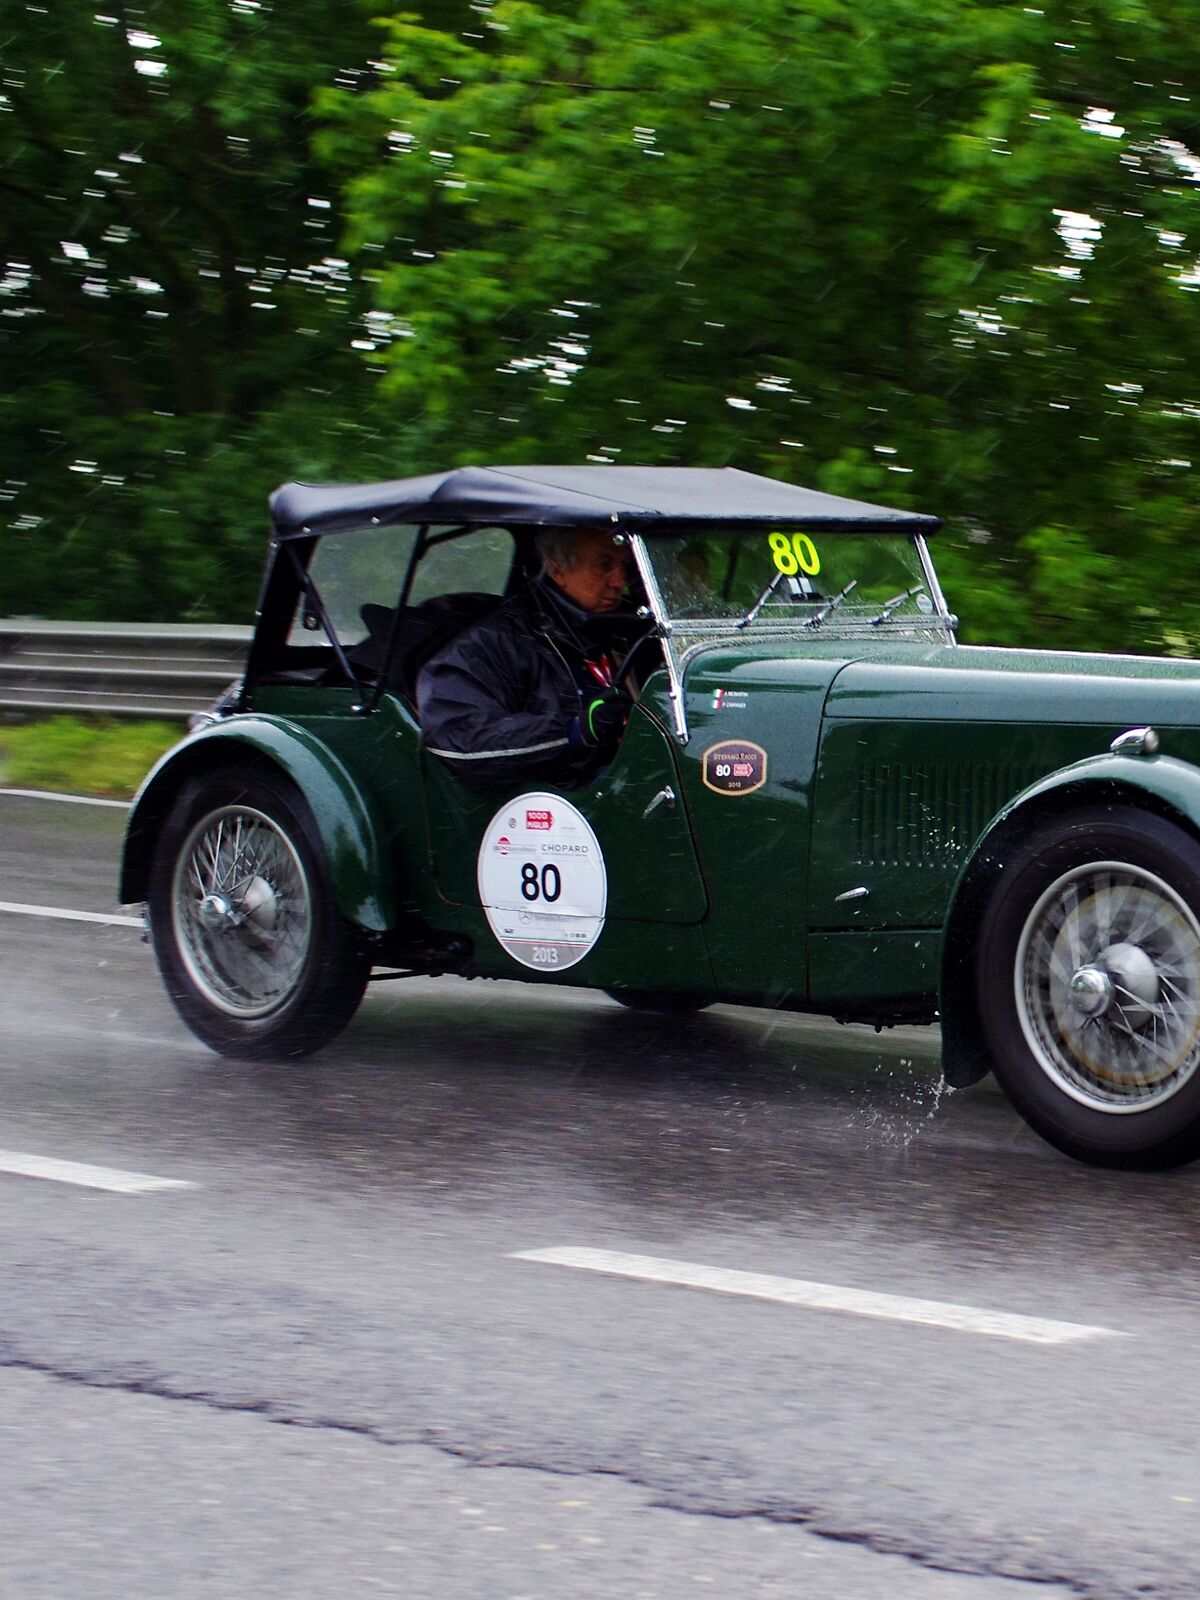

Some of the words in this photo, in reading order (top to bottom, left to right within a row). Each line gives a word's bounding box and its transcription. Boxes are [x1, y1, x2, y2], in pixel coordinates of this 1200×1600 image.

[768, 532, 820, 576] 80
[716, 764, 731, 777] 80
[528, 812, 548, 820] 1000
[541, 843, 589, 853] CHOPARD
[521, 862, 561, 903] 80
[532, 947, 559, 963] 2013
